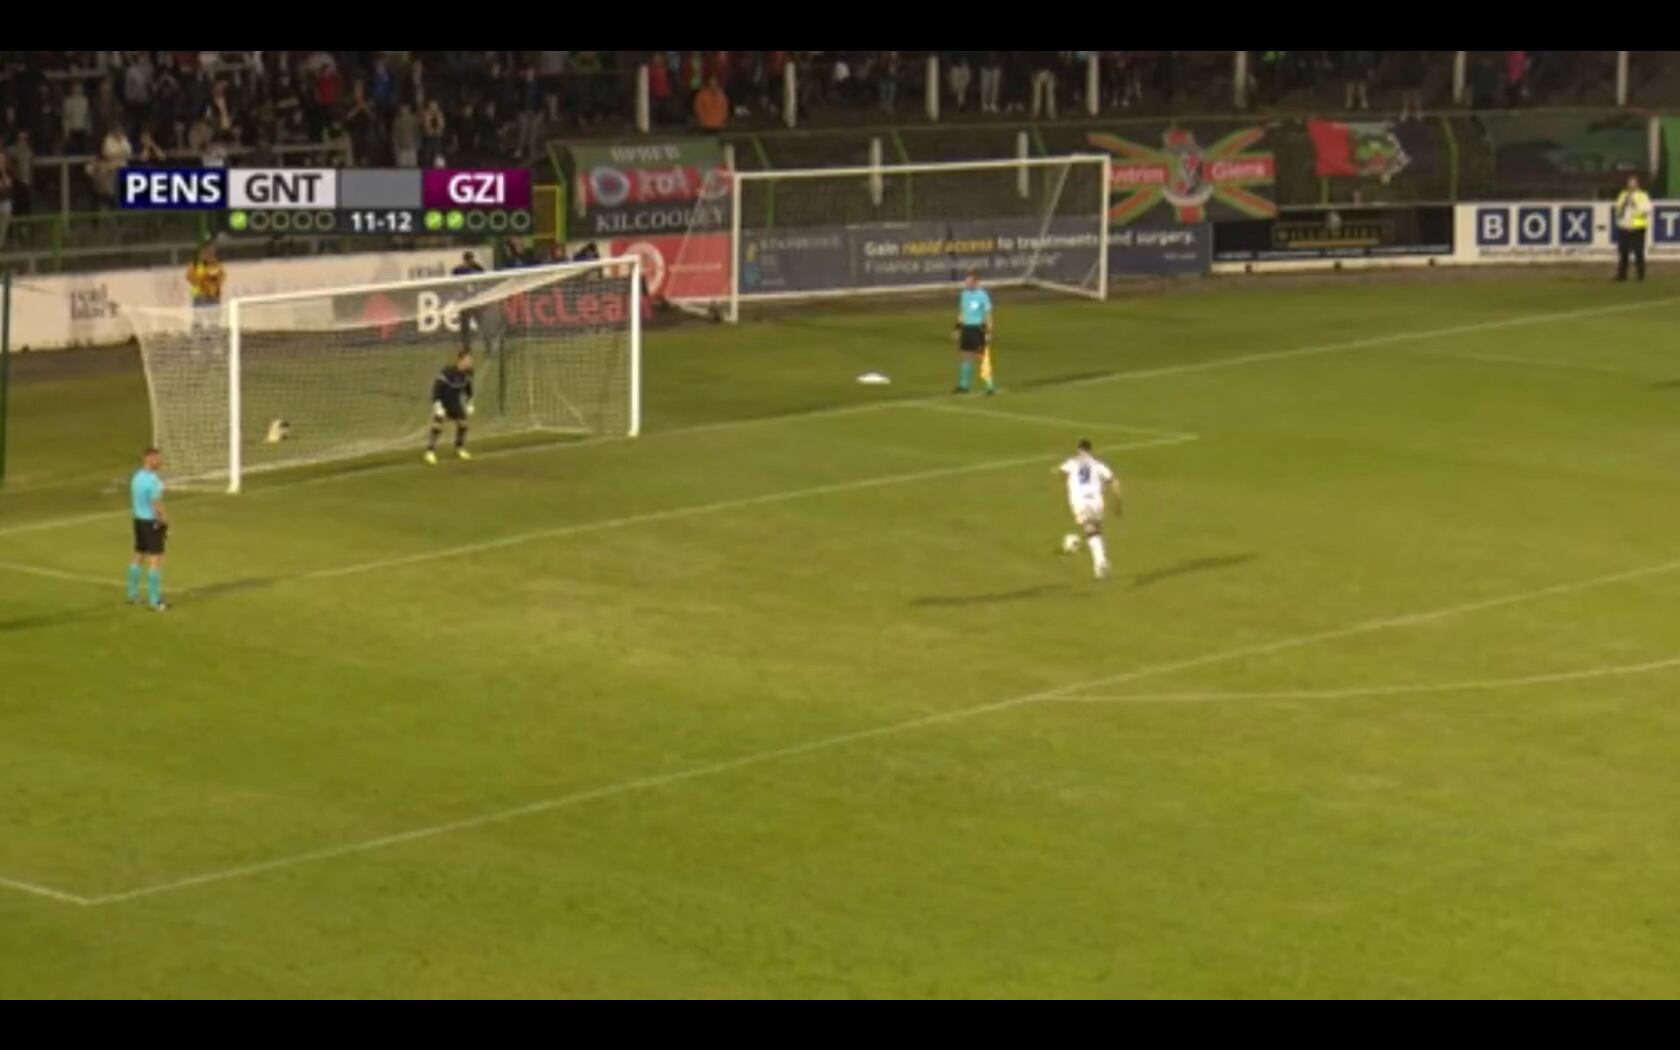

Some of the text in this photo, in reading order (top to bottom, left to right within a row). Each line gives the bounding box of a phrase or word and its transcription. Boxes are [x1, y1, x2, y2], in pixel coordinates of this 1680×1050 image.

[1482, 210, 1680, 240] BOX-T
[865, 240, 900, 257] Gain
[997, 237, 1015, 249] to
[1017, 232, 1100, 249] treatments
